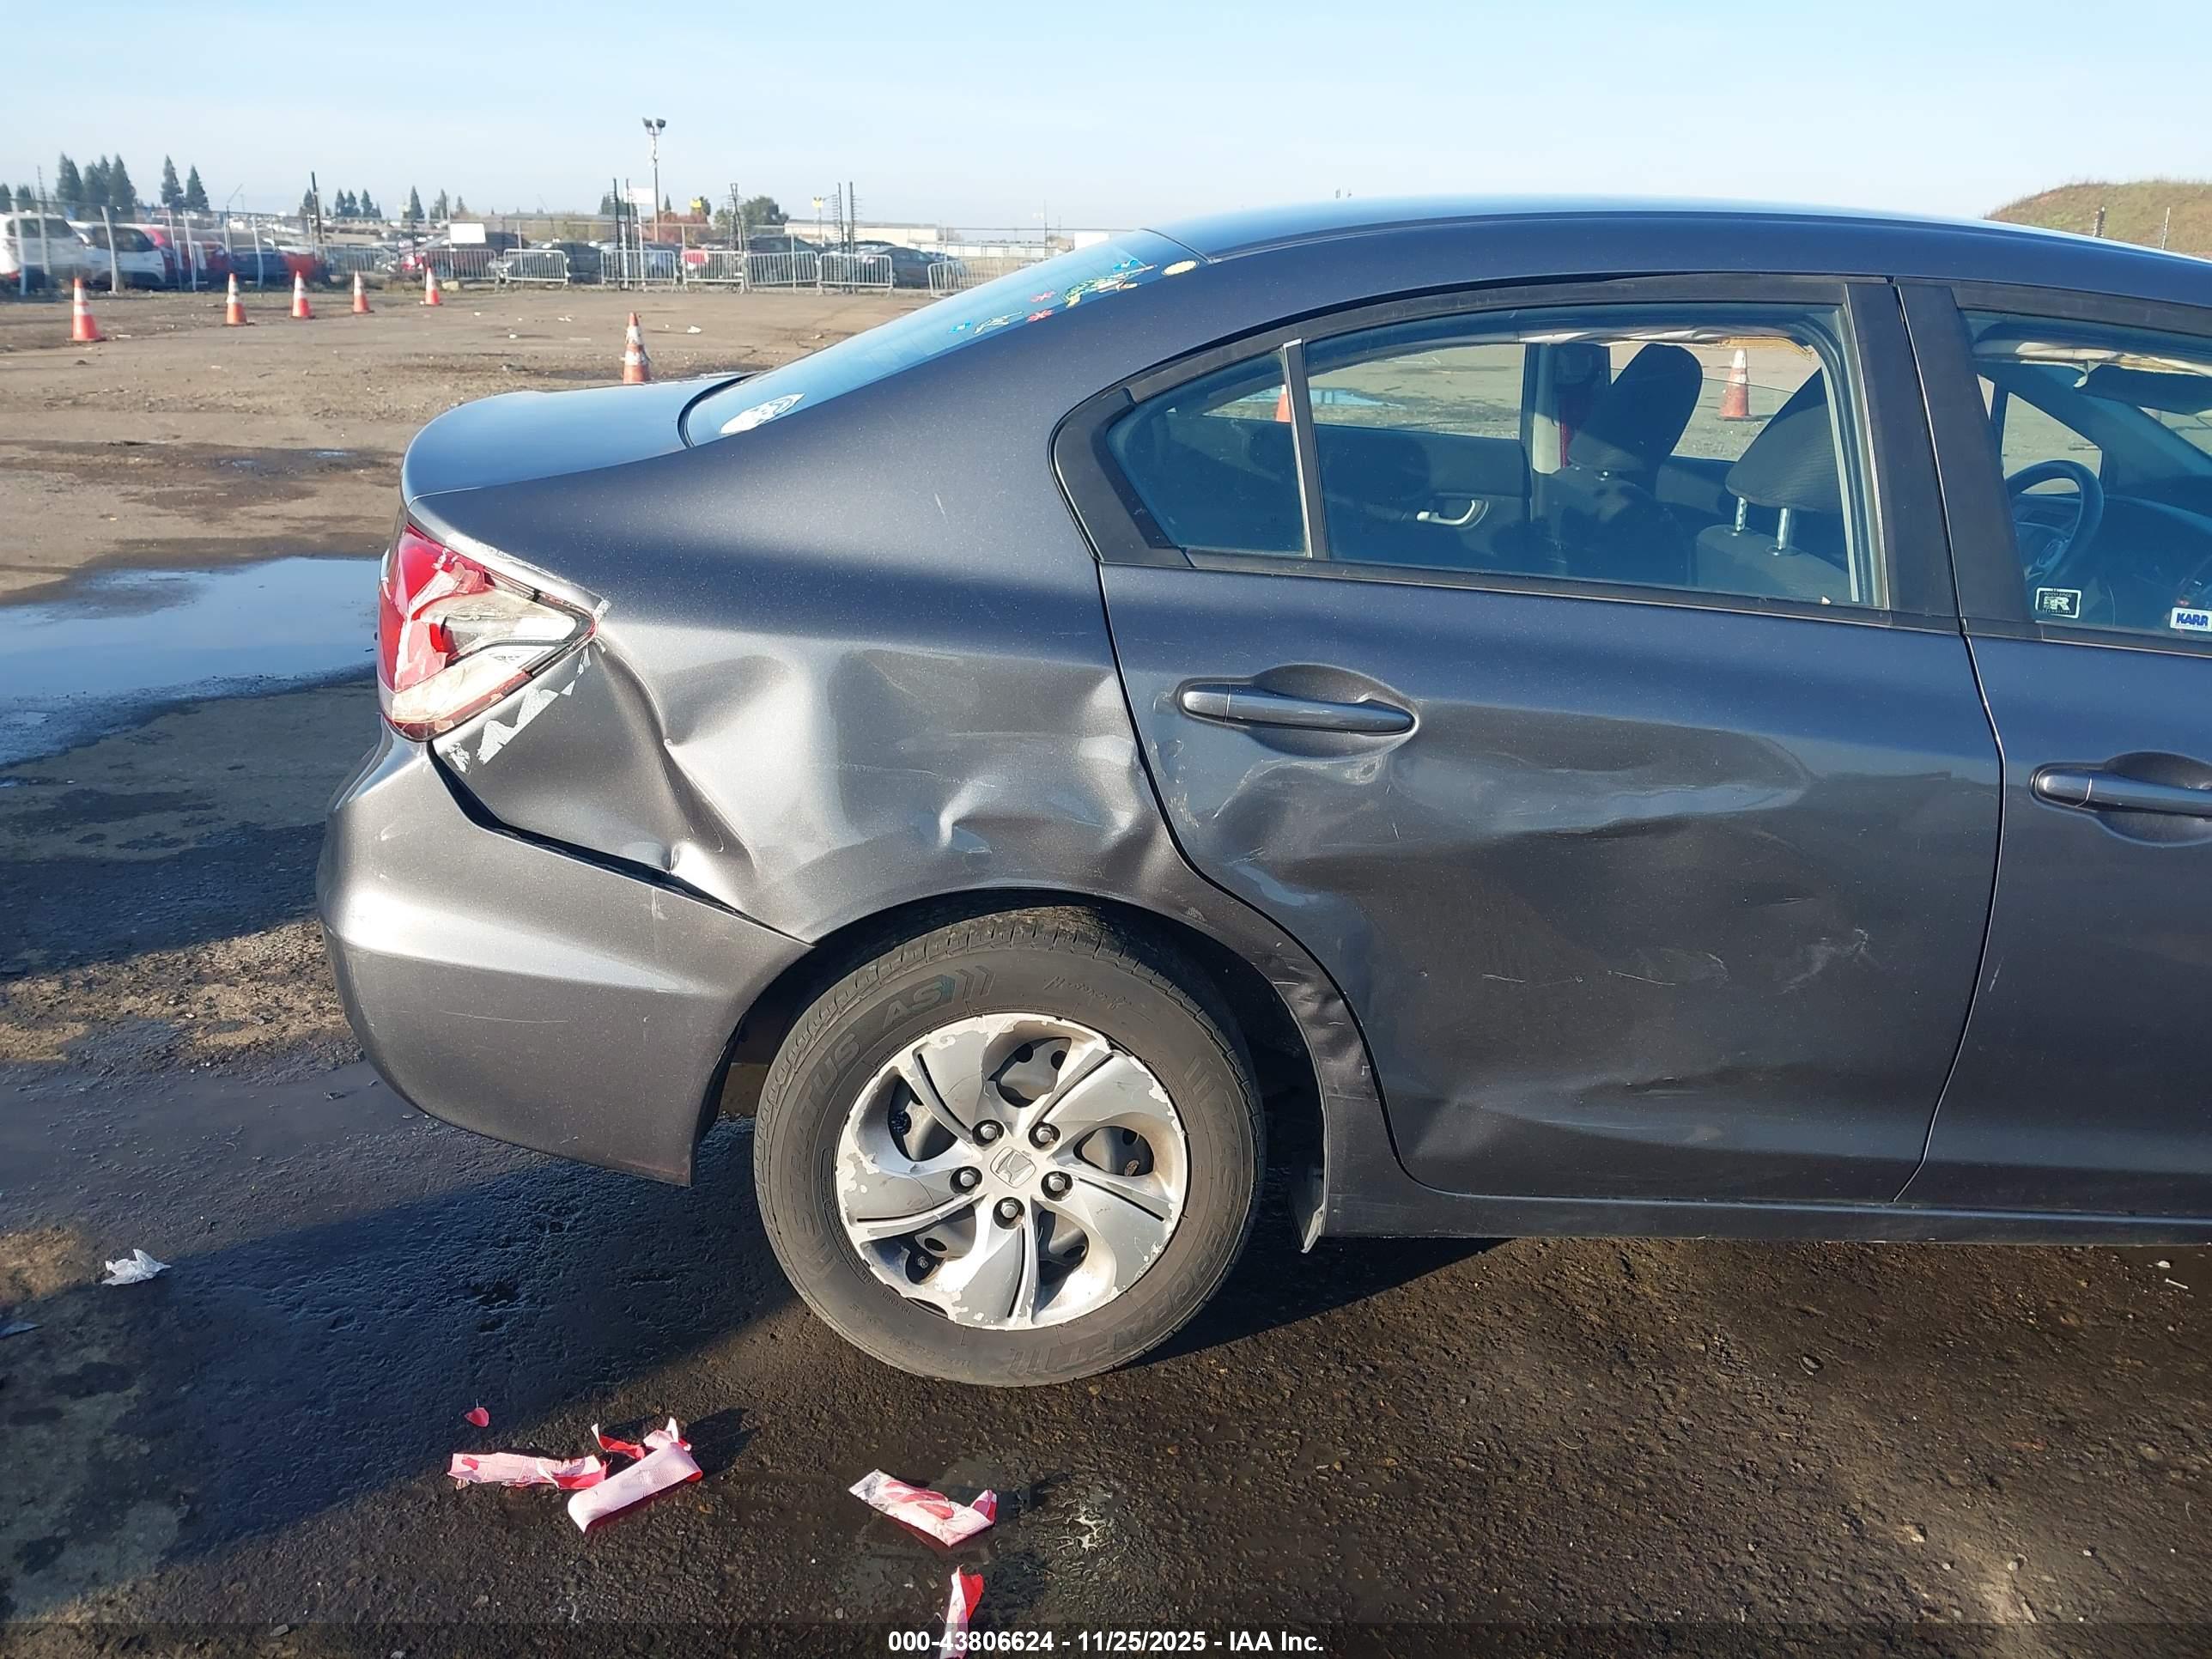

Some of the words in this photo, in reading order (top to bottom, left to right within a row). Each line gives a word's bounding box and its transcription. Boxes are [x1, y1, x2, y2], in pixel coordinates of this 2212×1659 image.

[2176, 612, 2209, 627] KARR
[790, 1032, 860, 1235] STRATUS
[881, 981, 945, 1031] AS
